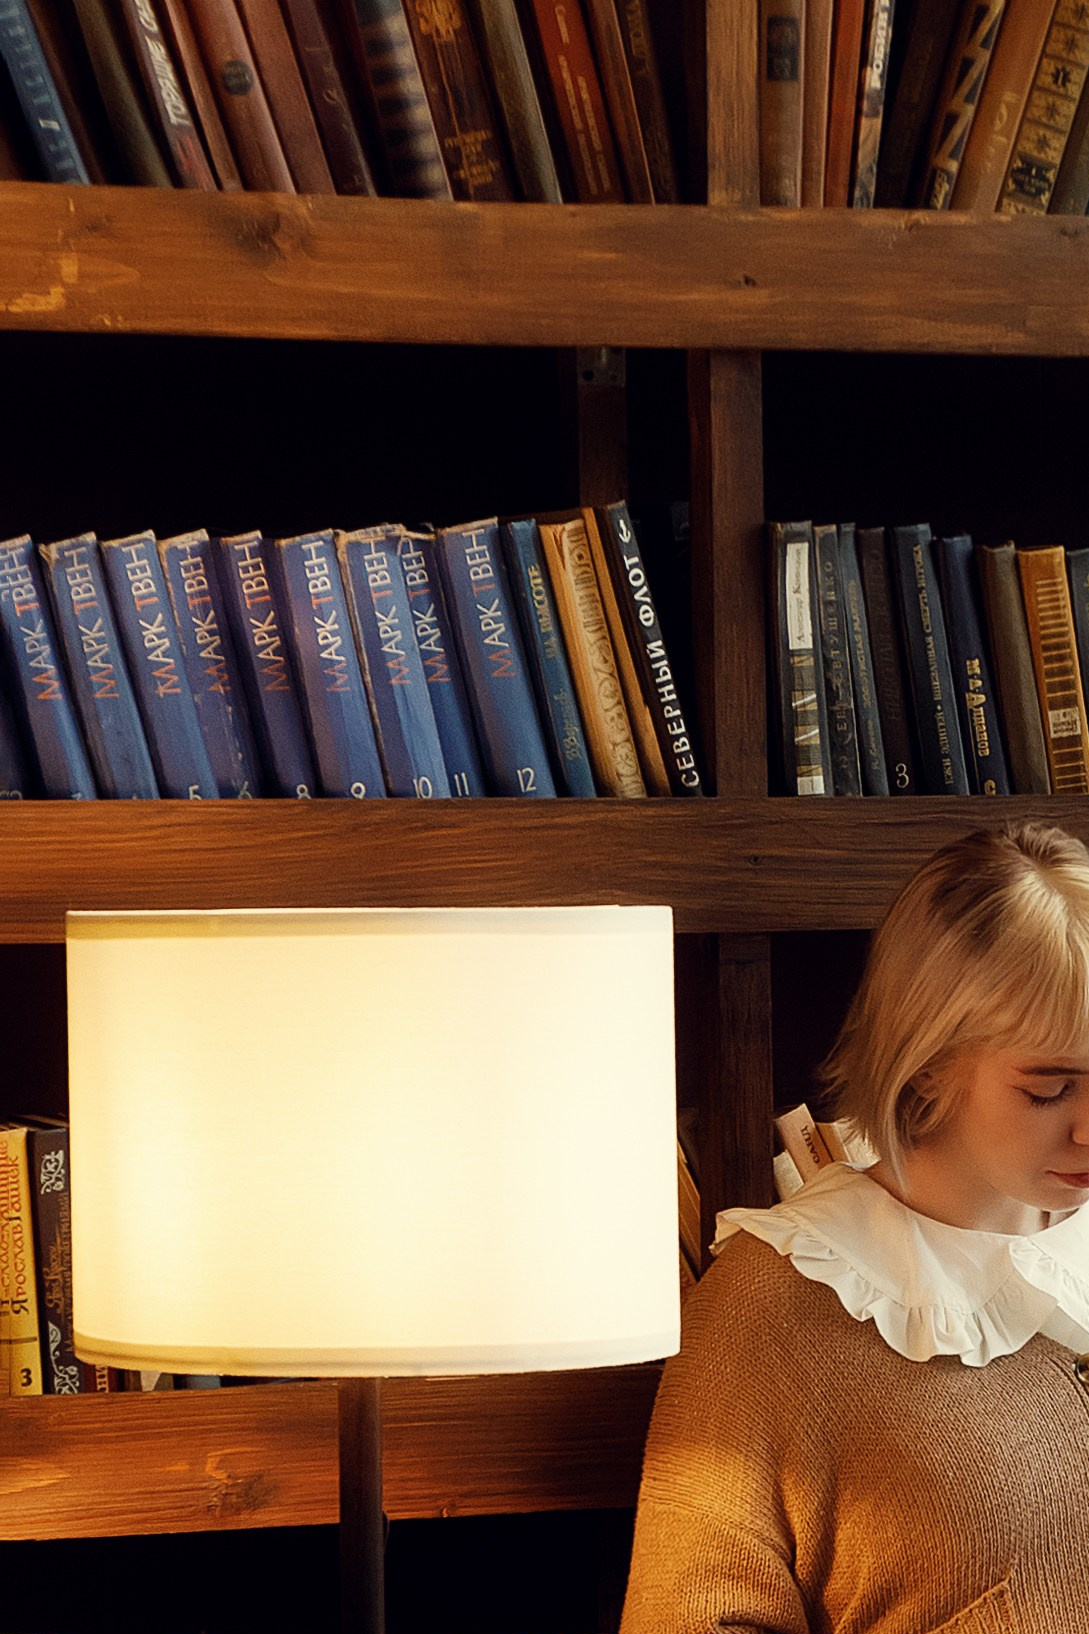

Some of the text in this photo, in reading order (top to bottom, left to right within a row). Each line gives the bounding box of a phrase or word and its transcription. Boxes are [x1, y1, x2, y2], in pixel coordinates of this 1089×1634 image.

[5, 545, 63, 700] МАРК ТВЕН
[63, 547, 120, 700] МАРК ТВЕН
[121, 541, 183, 699] МАРК ТВЕН
[177, 540, 232, 694] МАРК ТВЕН
[233, 538, 290, 693] МАРК ТВЕН
[301, 540, 350, 693] МАРК ТВЕН
[363, 537, 412, 685] МАРК ТВЕН
[401, 537, 451, 684] МАРК ТВЕН
[462, 528, 517, 678] МАРК ТВЕН
[527, 563, 554, 633] ВЫСОТЕ
[623, 553, 701, 788] СЕВЕРНЫЙ ФЛОТ
[917, 590, 933, 634] СМЕРТЬ
[924, 634, 942, 701] ВНЕЗАПНАЯ
[412, 775, 433, 799] 10
[453, 772, 470, 796] 11
[516, 766, 537, 793] 12
[895, 762, 910, 789] 3
[800, 1124, 821, 1165] САНД
[20, 1367, 33, 1387] 3
